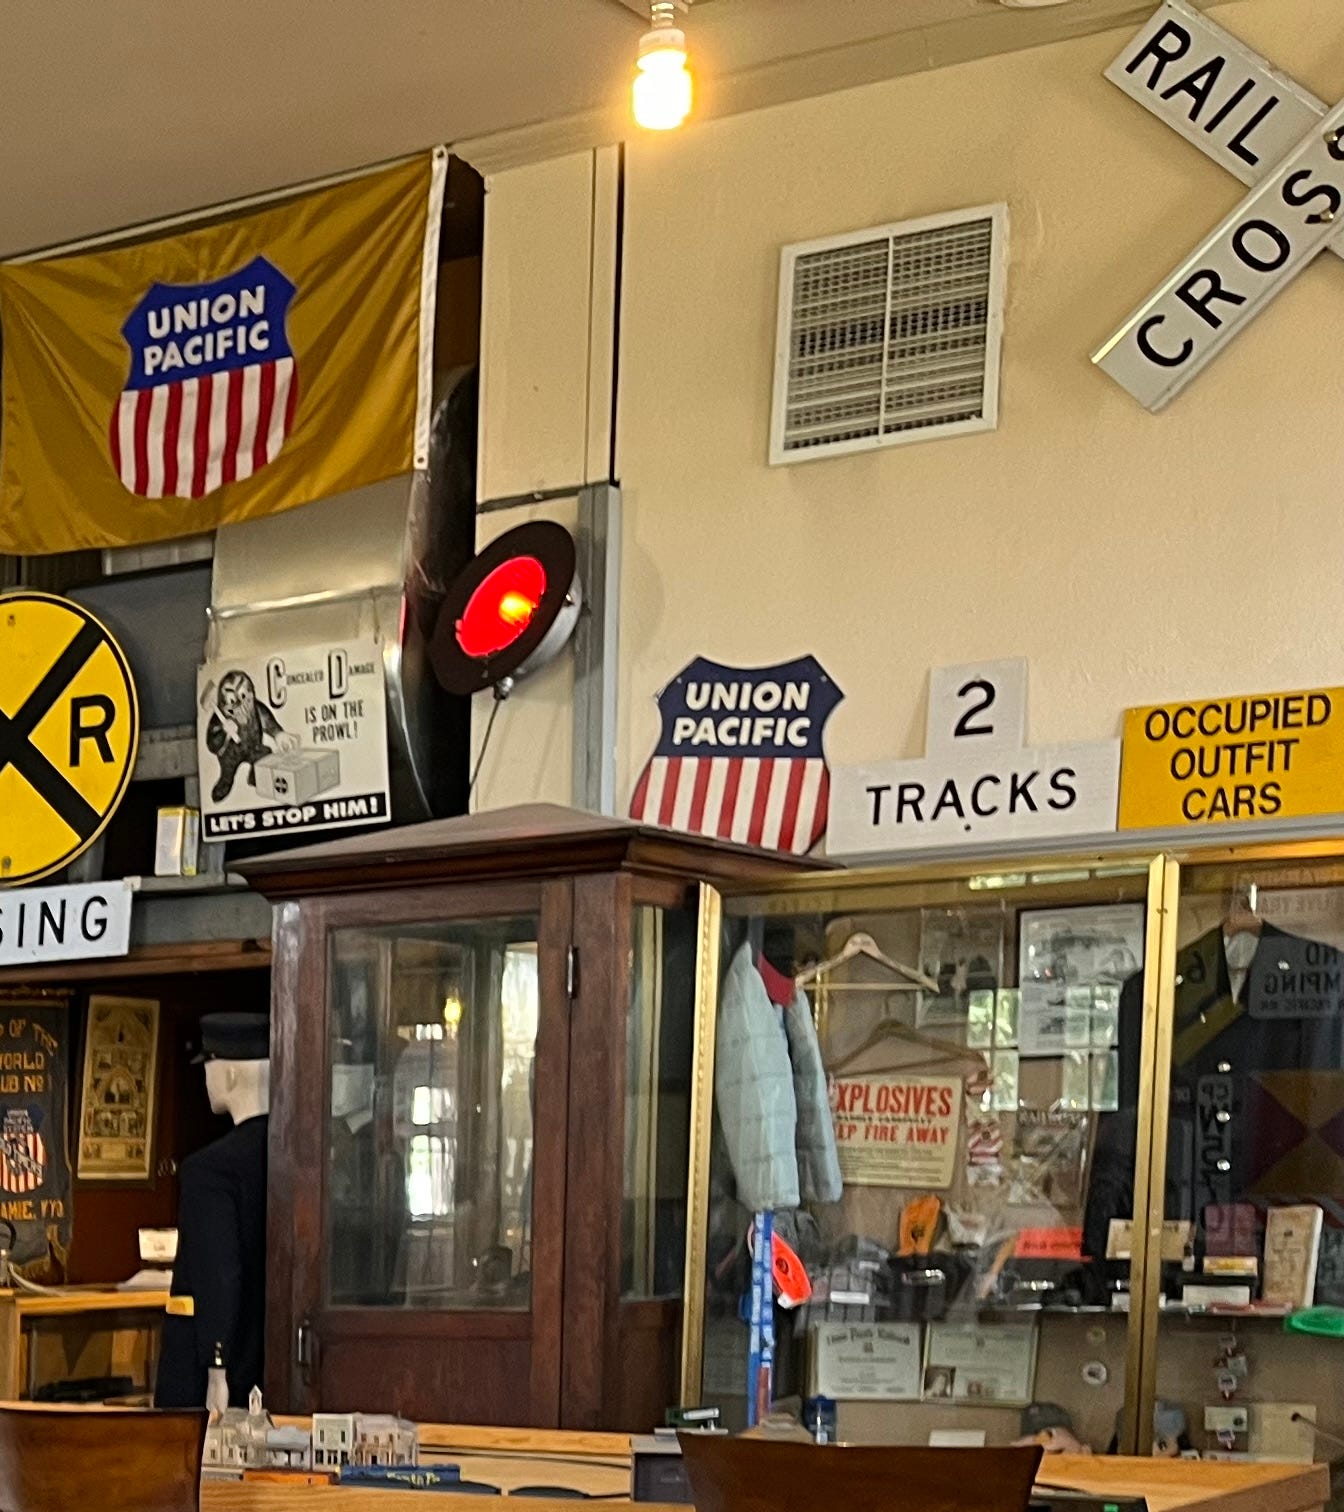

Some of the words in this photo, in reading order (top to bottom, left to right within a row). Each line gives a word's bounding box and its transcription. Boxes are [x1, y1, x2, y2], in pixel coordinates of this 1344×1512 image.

[1125, 19, 1280, 167] RAIL
[147, 286, 266, 339] UNION
[142, 322, 271, 377] PACIFIC
[304, 706, 317, 724] IS
[321, 704, 337, 721] ON
[343, 700, 365, 719] THE
[683, 681, 811, 711] UNION
[952, 678, 996, 737] 2
[69, 693, 115, 767] R
[312, 721, 359, 744] PROWL!
[672, 716, 812, 747] PACIFIC
[1144, 693, 1332, 742] OCCUPIED
[1169, 738, 1300, 780] OUTFIT
[210, 813, 256, 833] LET'S
[262, 805, 317, 828] STOP
[323, 796, 379, 819] HIM!
[865, 767, 1078, 827] TRACKS
[1181, 781, 1283, 821] CARS
[8, 1018, 27, 1039] OF
[31, 1023, 59, 1057] THE
[835, 1083, 954, 1118] XPLOSIVES
[837, 1123, 858, 1141] EP
[864, 1124, 900, 1142] FIRE
[906, 1125, 950, 1145] AWAY
